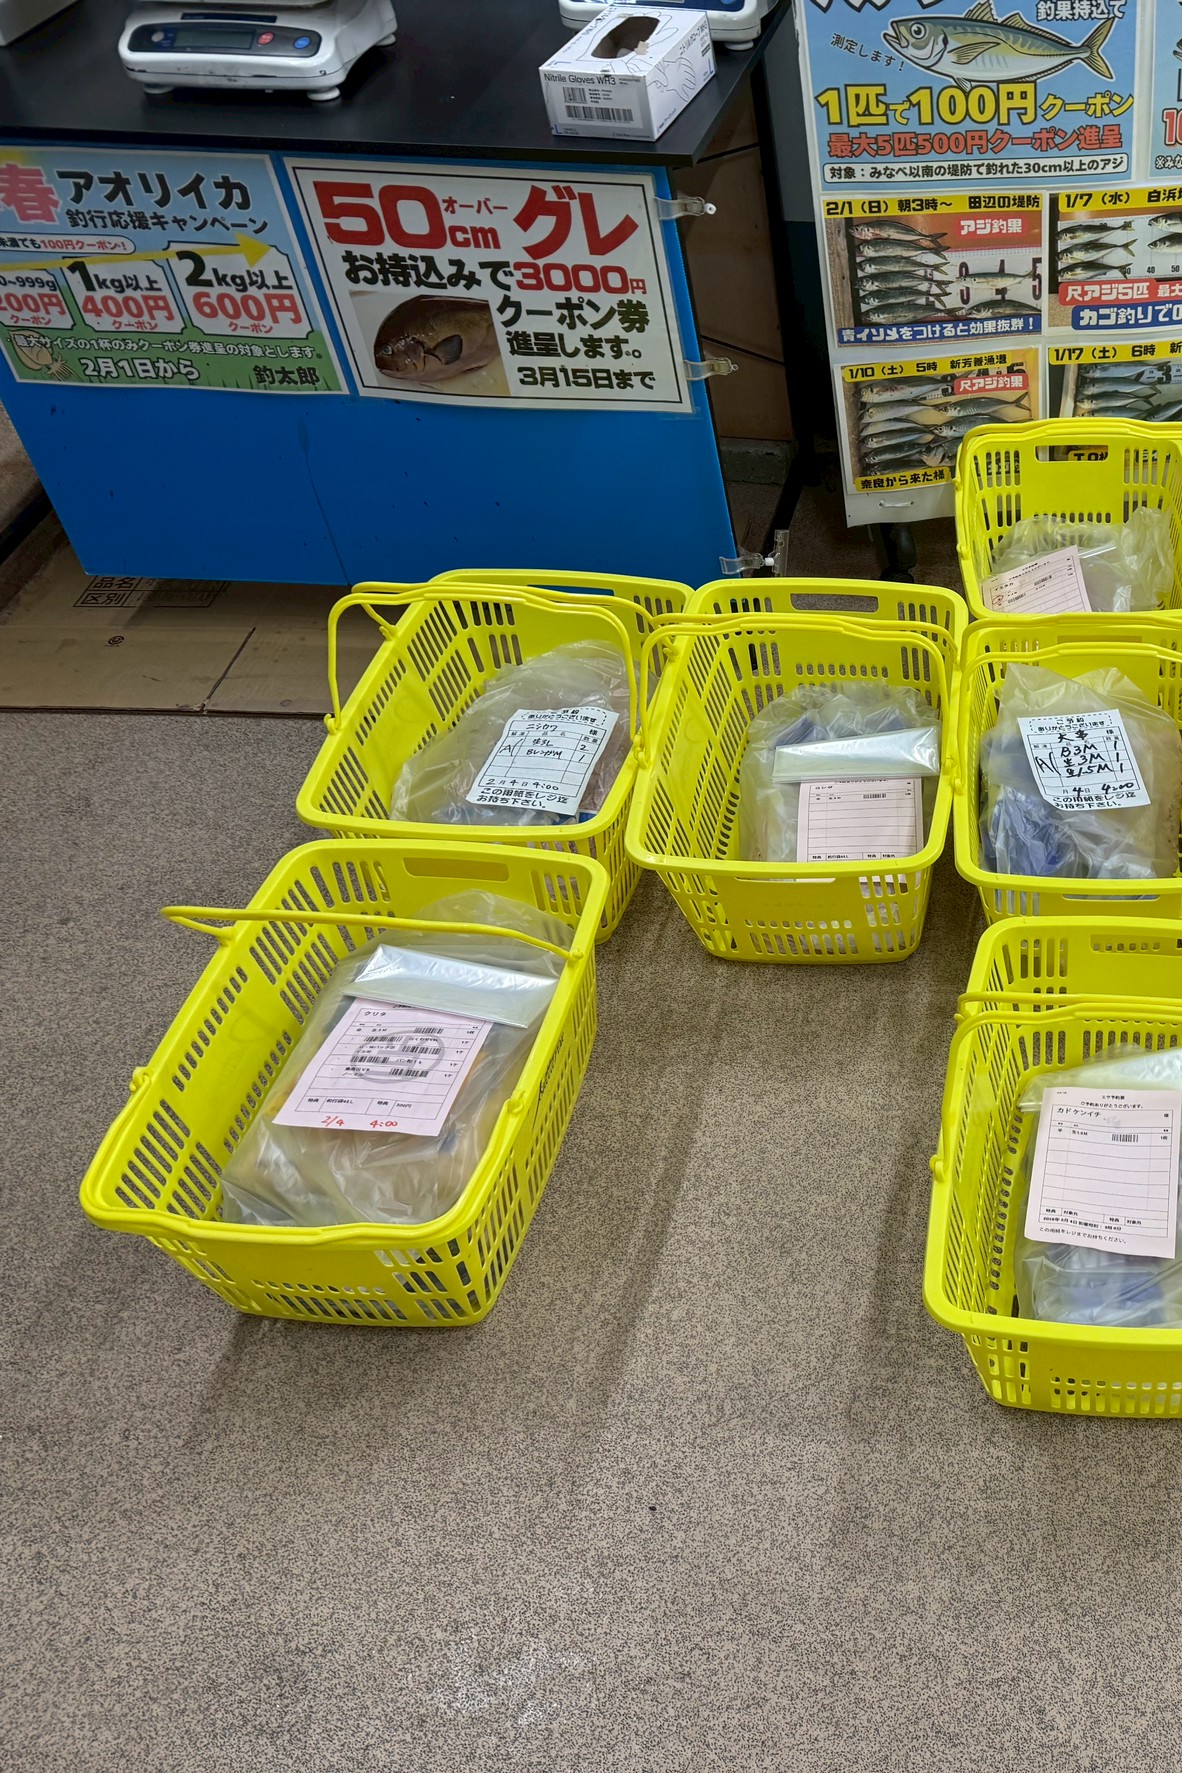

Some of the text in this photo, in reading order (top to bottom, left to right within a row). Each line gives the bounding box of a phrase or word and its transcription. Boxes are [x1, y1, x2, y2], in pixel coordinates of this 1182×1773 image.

[543, 73, 567, 83] Nitrile
[568, 74, 596, 85] Gloves
[827, 124, 1124, 158] 最大5匹500円クーポン進呈
[0, 163, 60, 224] 春
[55, 168, 252, 211] アオリイカ
[66, 208, 269, 236] 釣行応援キャンペーン
[513, 183, 640, 262] グレ
[959, 217, 1024, 236] アジ釣果
[65, 259, 164, 294] 1kg以上
[176, 250, 294, 293] 2kg以上
[9, 314, 53, 327] クーポン
[81, 294, 176, 322] 400円
[191, 291, 304, 326] 600円
[496, 294, 651, 335] クーポン券
[111, 318, 159, 332] クーポン
[227, 321, 275, 335] クーポン
[79, 356, 202, 381] 2月1日から
[252, 365, 321, 387] 釣太郎
[516, 364, 657, 392] 3月15日まで
[959, 375, 1025, 392] 尺アジ釣果
[860, 470, 947, 491] 奈良から来た様
[321, 1115, 345, 1127] 2/4
